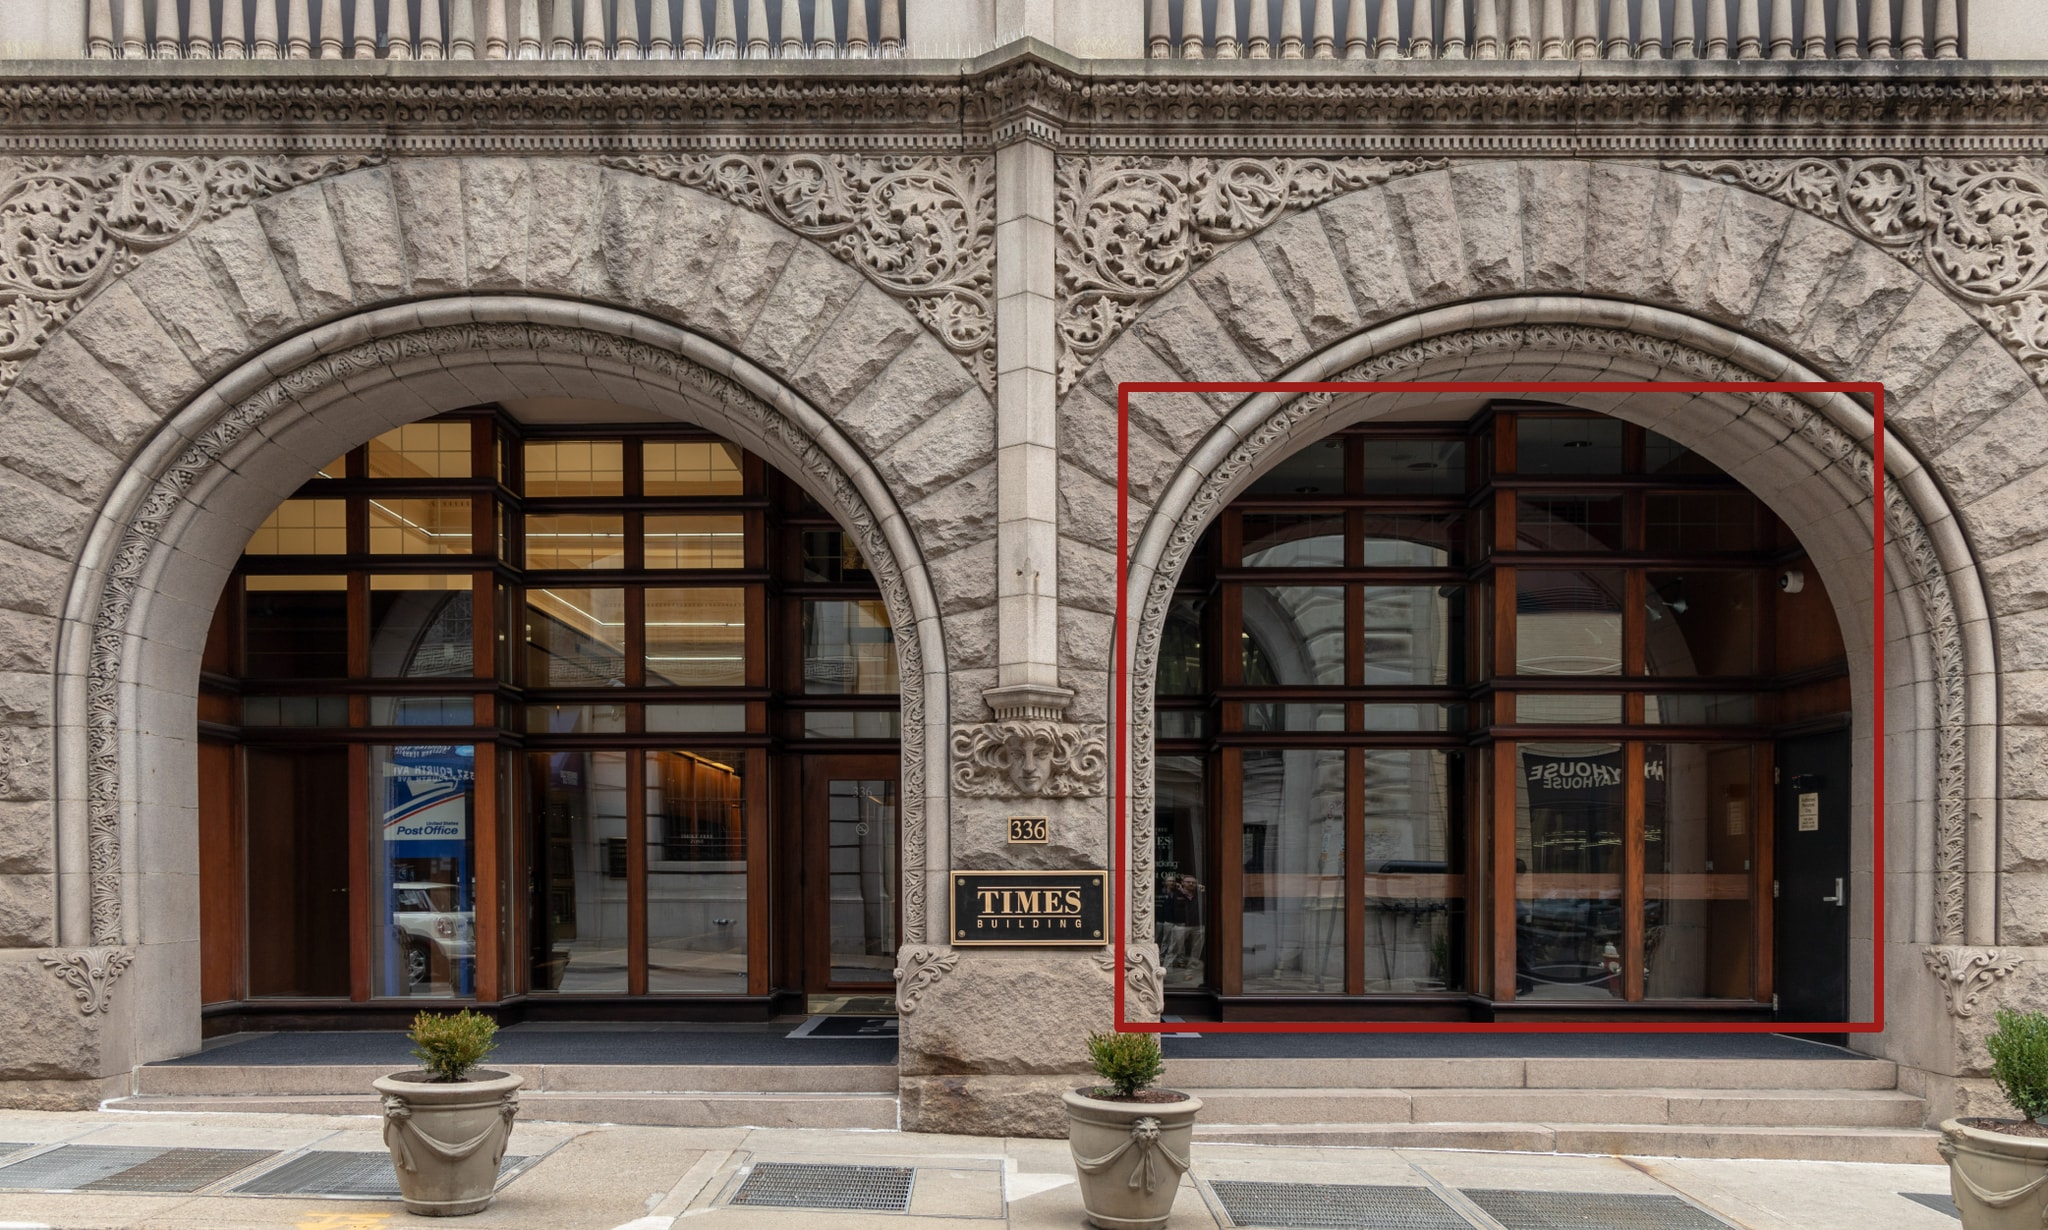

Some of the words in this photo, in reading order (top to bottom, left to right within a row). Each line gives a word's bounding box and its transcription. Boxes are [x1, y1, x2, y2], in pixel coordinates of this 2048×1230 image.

[397, 826, 424, 836] Post
[424, 825, 459, 836] Office
[1011, 820, 1046, 840] 336
[977, 890, 1082, 914] TIMES
[977, 919, 1082, 929] BUILDING
